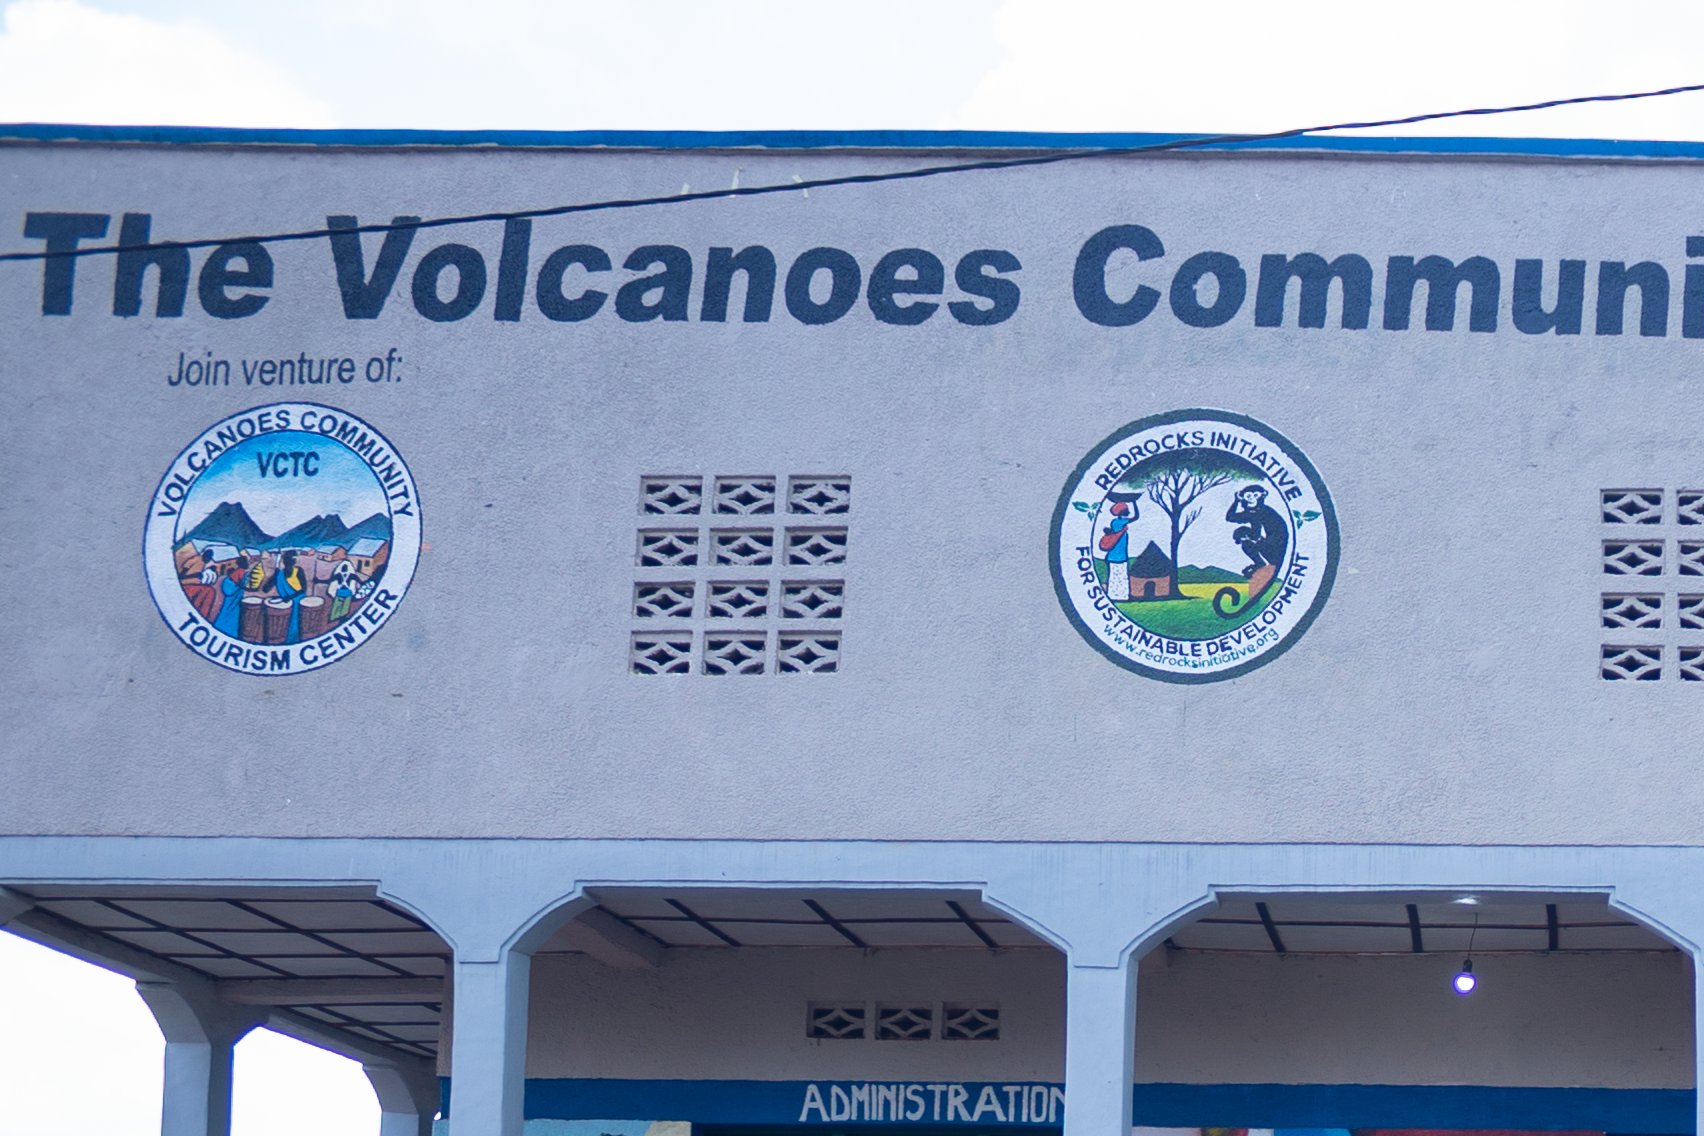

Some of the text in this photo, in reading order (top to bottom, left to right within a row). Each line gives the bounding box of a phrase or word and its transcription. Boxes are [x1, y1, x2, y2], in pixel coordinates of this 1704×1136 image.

[23, 211, 275, 319] The
[326, 217, 1022, 326] Volcanoes
[167, 348, 404, 387] Join venture of:
[157, 410, 414, 518] VOLCANOES COMMUNITY
[257, 452, 320, 478] VCTC
[1094, 431, 1303, 502] REDROCKS INITIATIVE
[178, 589, 398, 671] TOURISM CENTER
[1075, 546, 1310, 658] FOR SUSTAINABLE DEVELOPMENT
